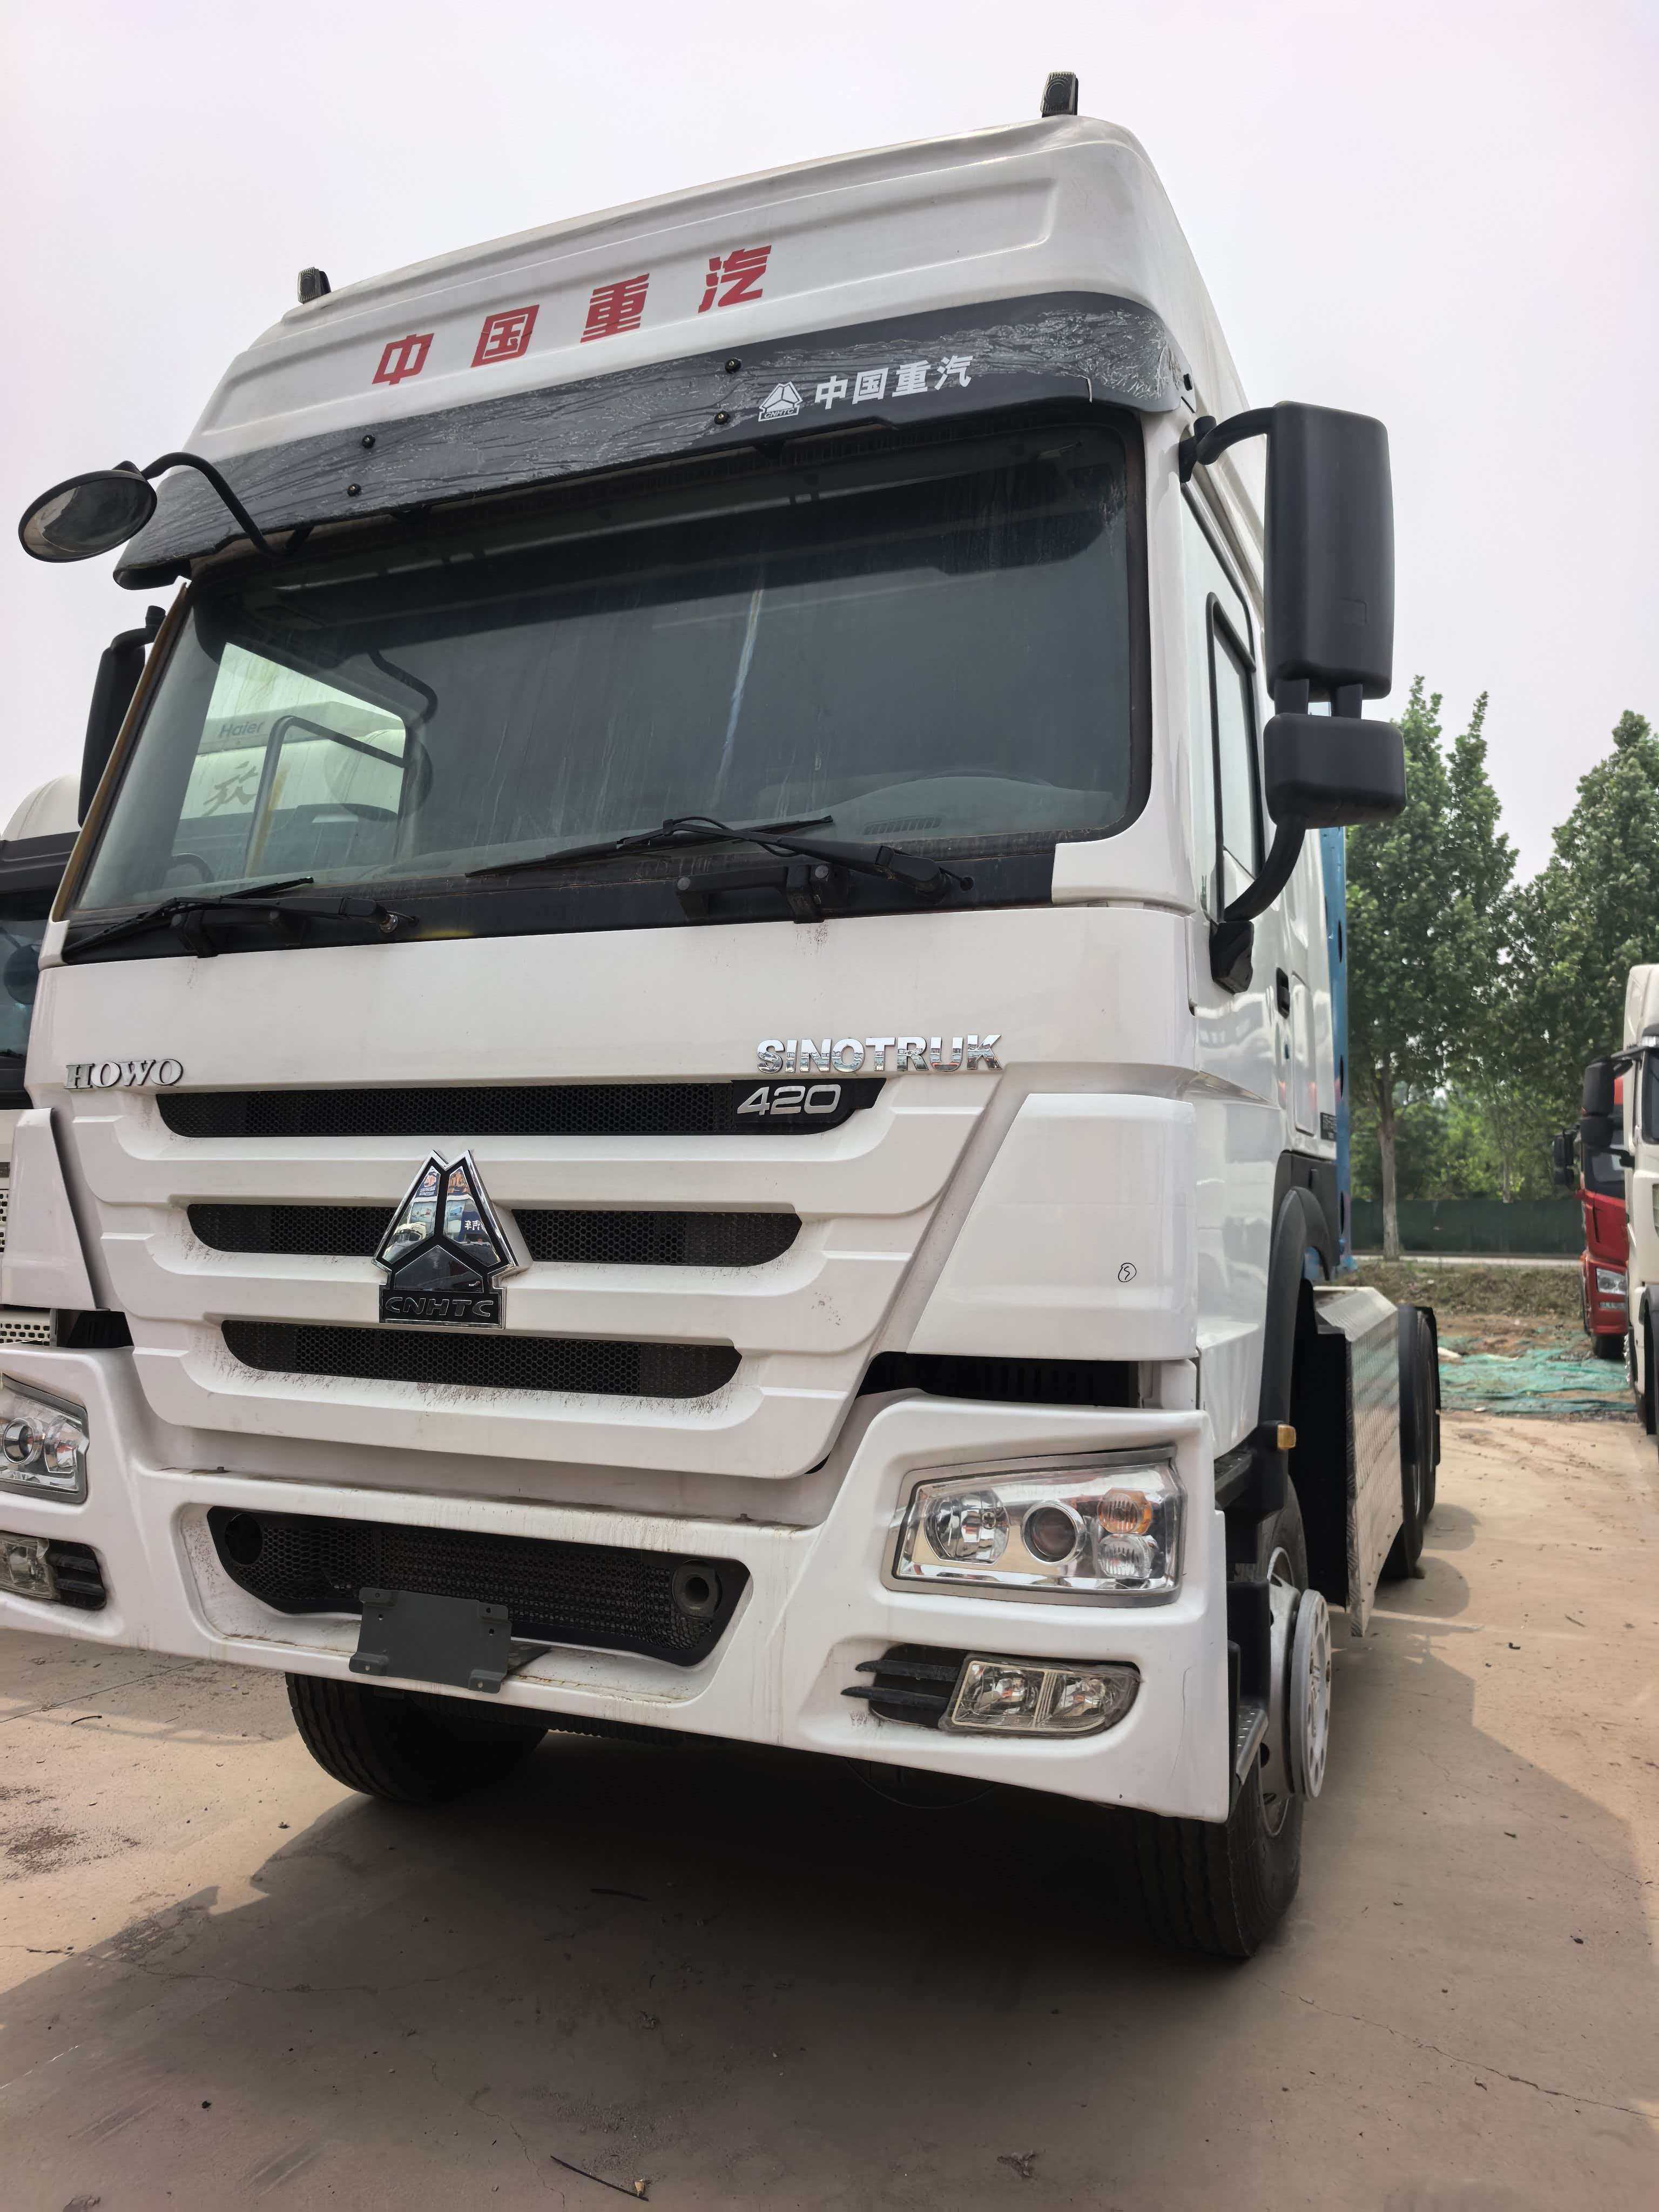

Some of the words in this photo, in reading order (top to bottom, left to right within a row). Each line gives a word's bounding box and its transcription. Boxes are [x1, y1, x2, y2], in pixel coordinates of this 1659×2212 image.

[372, 245, 772, 386] 中国重汽
[814, 355, 973, 410] 中国重汽
[764, 408, 794, 419] CNHTC
[219, 721, 266, 739] Haier
[757, 1034, 1003, 1074] SINOTRUK
[64, 1058, 184, 1090] HOWO
[737, 1084, 842, 1116] 420
[385, 1297, 494, 1317] CNHTC
